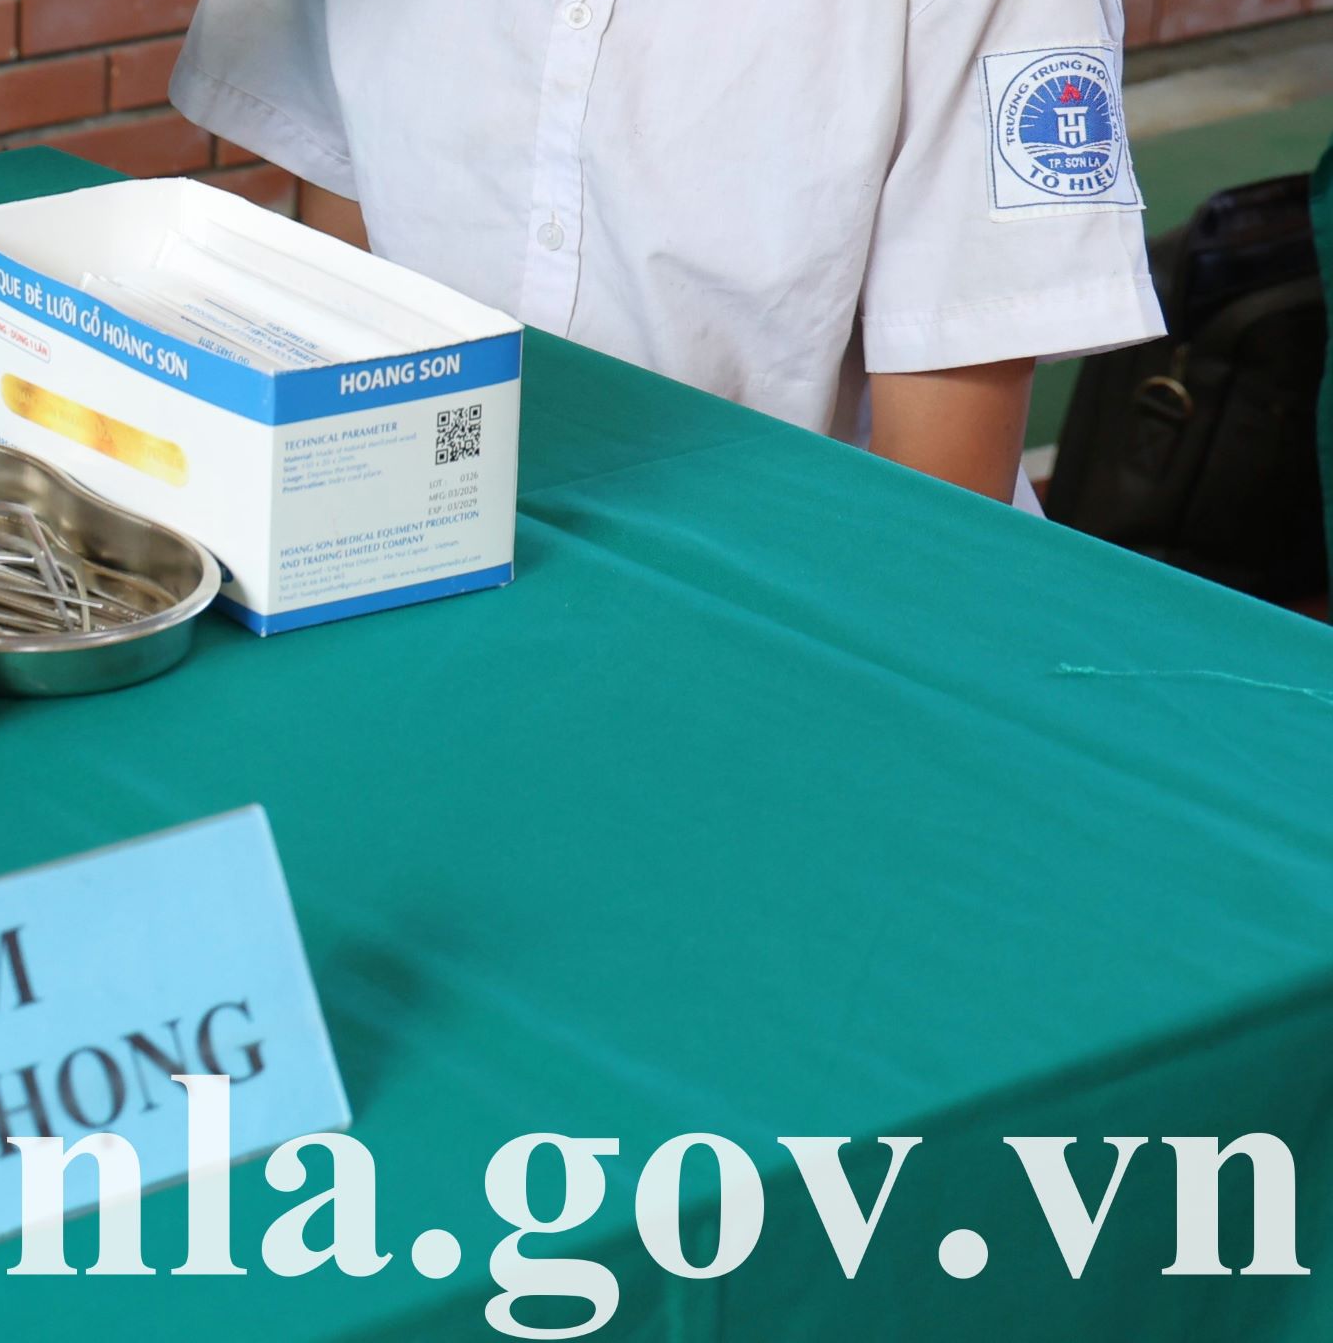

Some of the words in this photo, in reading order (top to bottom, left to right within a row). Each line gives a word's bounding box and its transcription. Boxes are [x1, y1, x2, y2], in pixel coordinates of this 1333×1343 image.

[1030, 60, 1082, 82] TRUNG
[1029, 165, 1060, 189] TÔ
[1088, 156, 1101, 168] LA
[25, 281, 43, 310] ĐÈ
[46, 294, 77, 326] LƯỠI
[80, 305, 101, 337] GỖ
[103, 321, 153, 365] HOÀNG
[156, 347, 189, 381] SƠN
[340, 362, 415, 395] HOANG
[419, 353, 461, 381] SON
[284, 434, 338, 451] TECHNICAL
[342, 422, 398, 440] PARAMETER
[280, 544, 314, 558] HOANG
[315, 539, 333, 551] SON
[336, 531, 375, 547] MEDICAL
[426, 509, 480, 529] PRODUCTION
[279, 558, 300, 571] AND
[303, 549, 342, 566] TRADING
[344, 542, 381, 558] LIMITED
[382, 534, 425, 549] COMPANY
